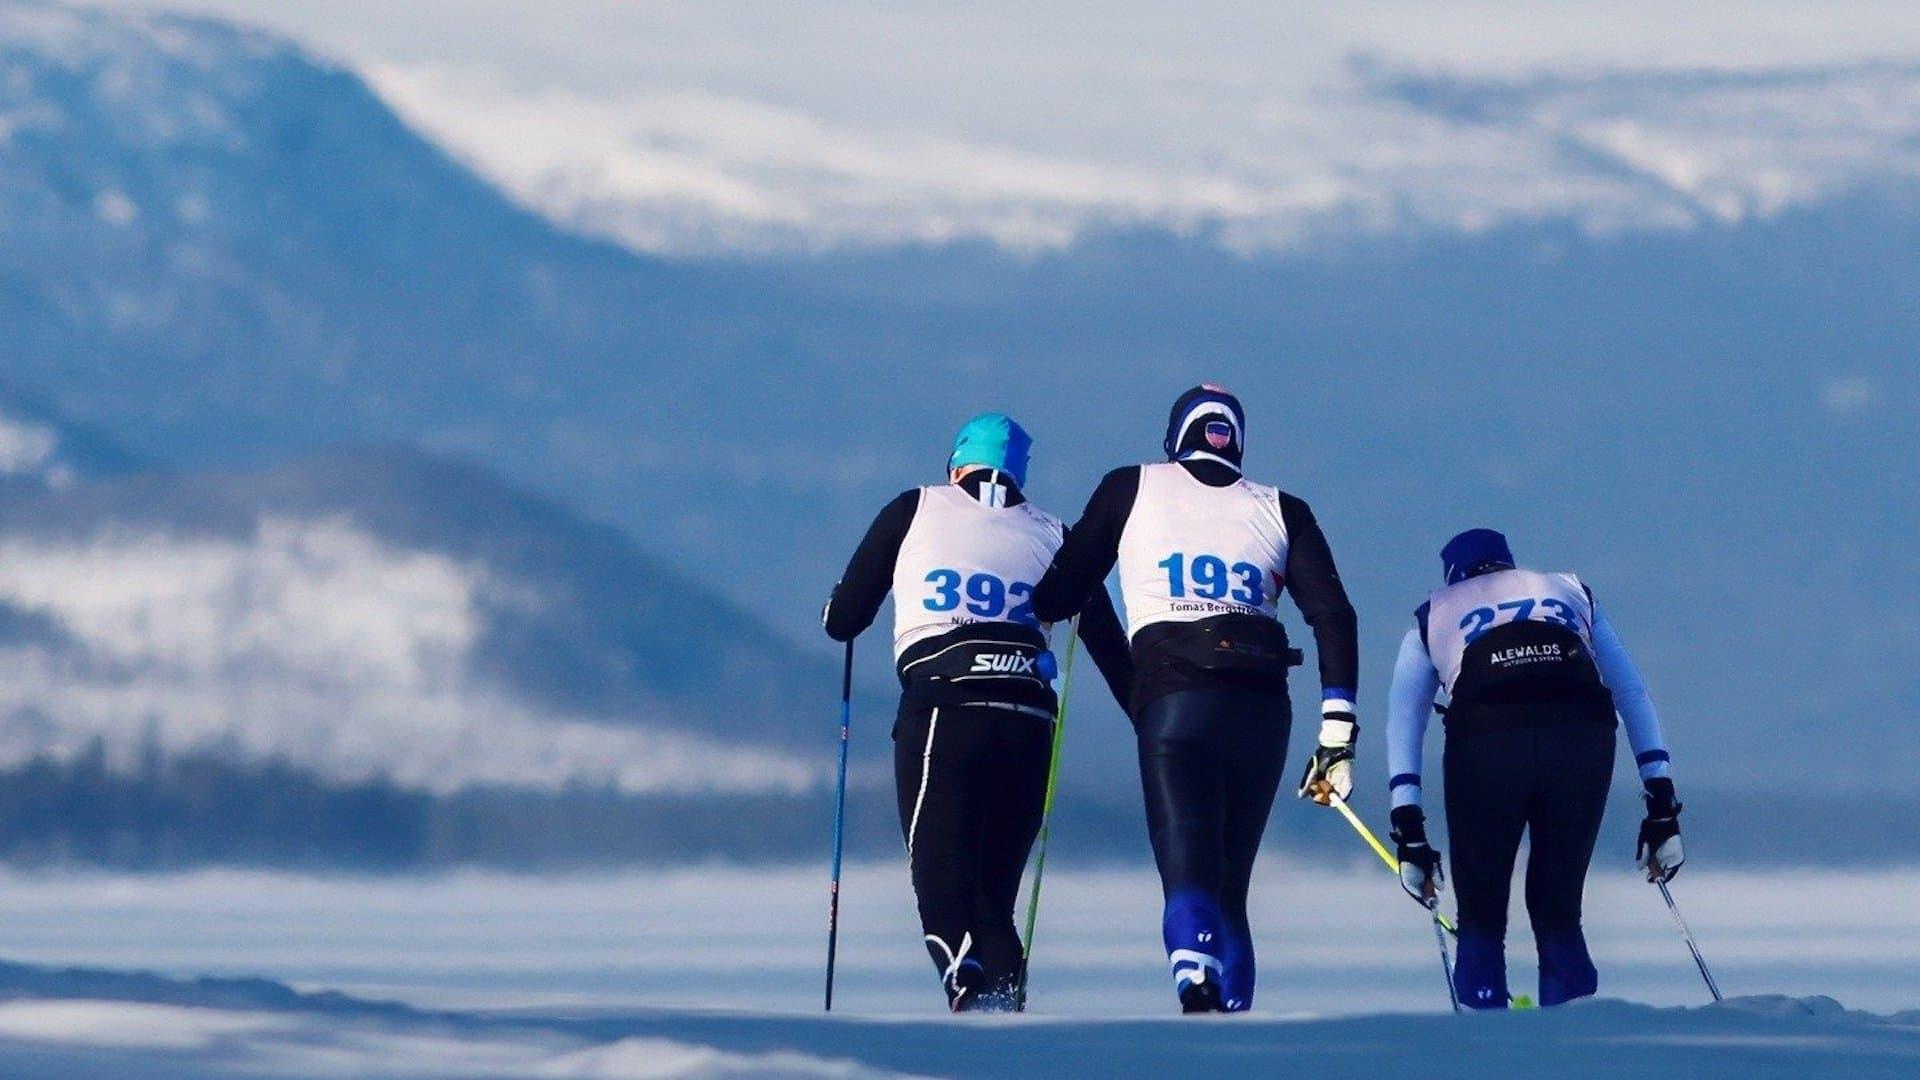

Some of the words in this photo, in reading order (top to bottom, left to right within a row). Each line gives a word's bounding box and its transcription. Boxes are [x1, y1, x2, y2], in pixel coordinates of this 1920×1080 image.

[922, 568, 1038, 624] 392
[1158, 552, 1265, 606] 193
[1170, 602, 1205, 612] Tomas
[1459, 598, 1580, 645] 273
[1491, 643, 1561, 665] ALEWALDS
